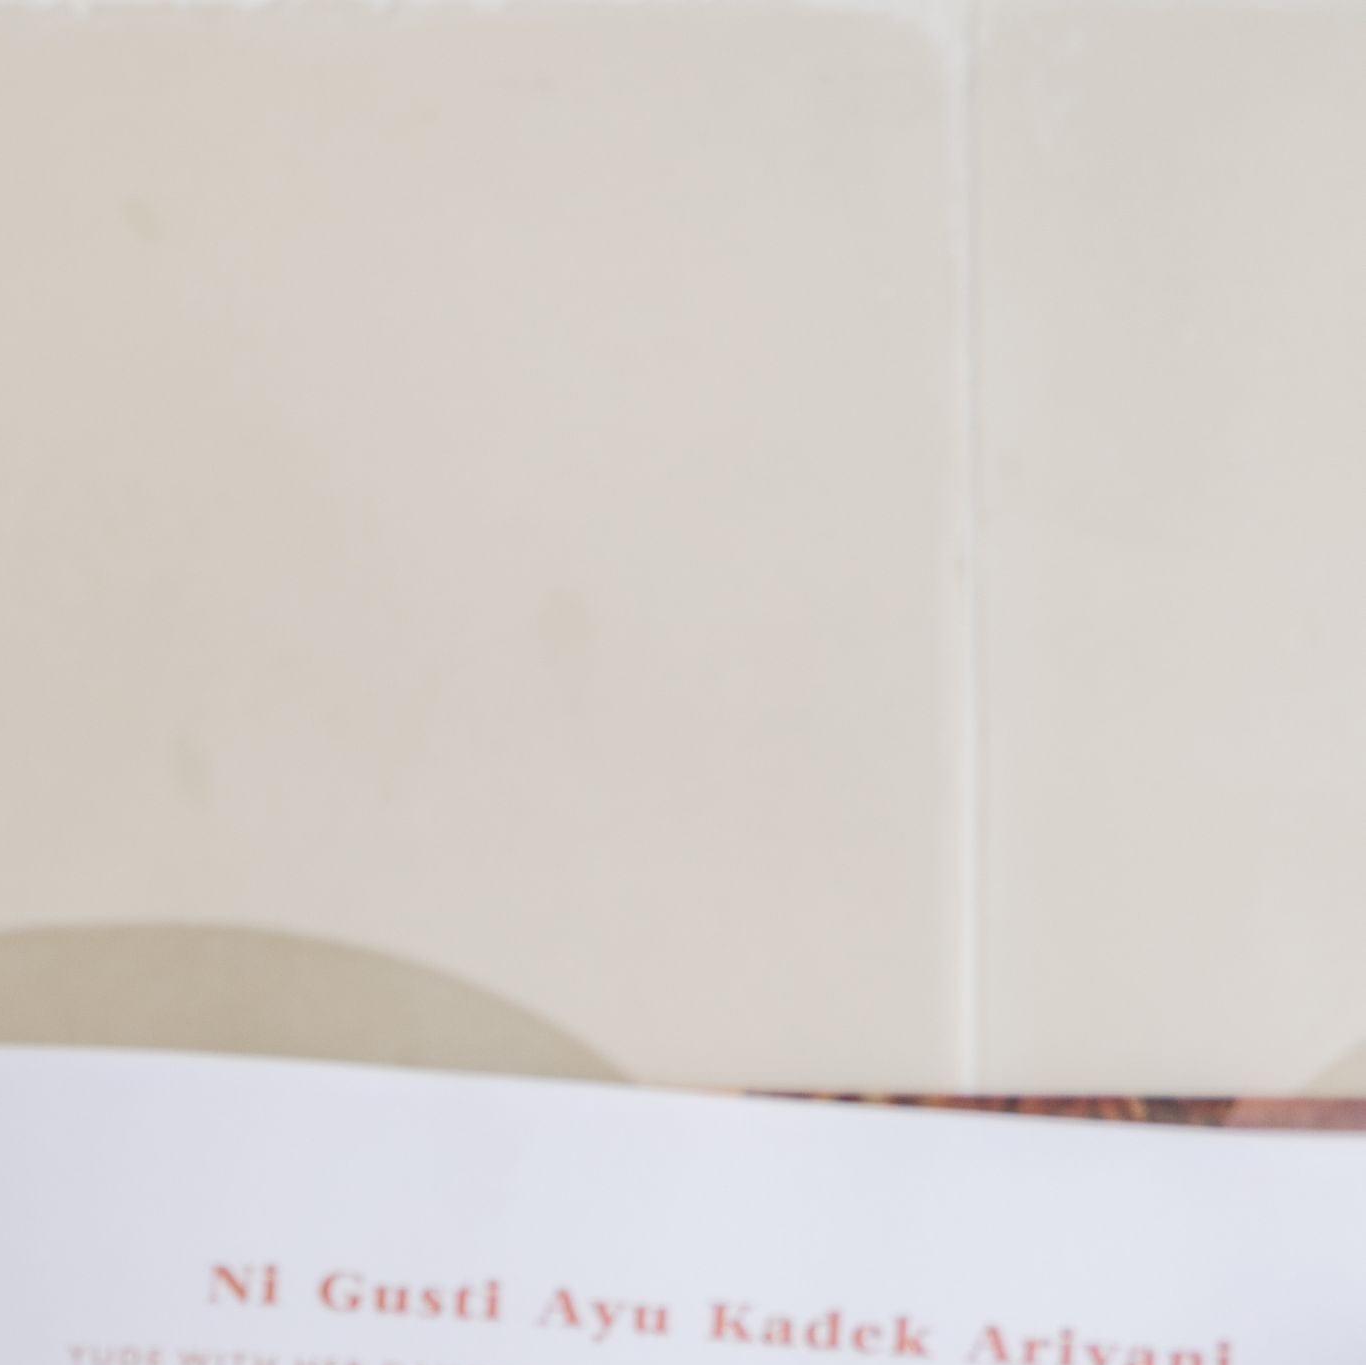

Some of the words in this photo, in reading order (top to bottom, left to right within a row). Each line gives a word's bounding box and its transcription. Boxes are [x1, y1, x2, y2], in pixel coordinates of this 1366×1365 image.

[212, 1264, 279, 1307] Ni
[319, 1270, 501, 1322] Gusti
[536, 1288, 670, 1342] Ayu
[709, 1302, 928, 1359] Kadek
